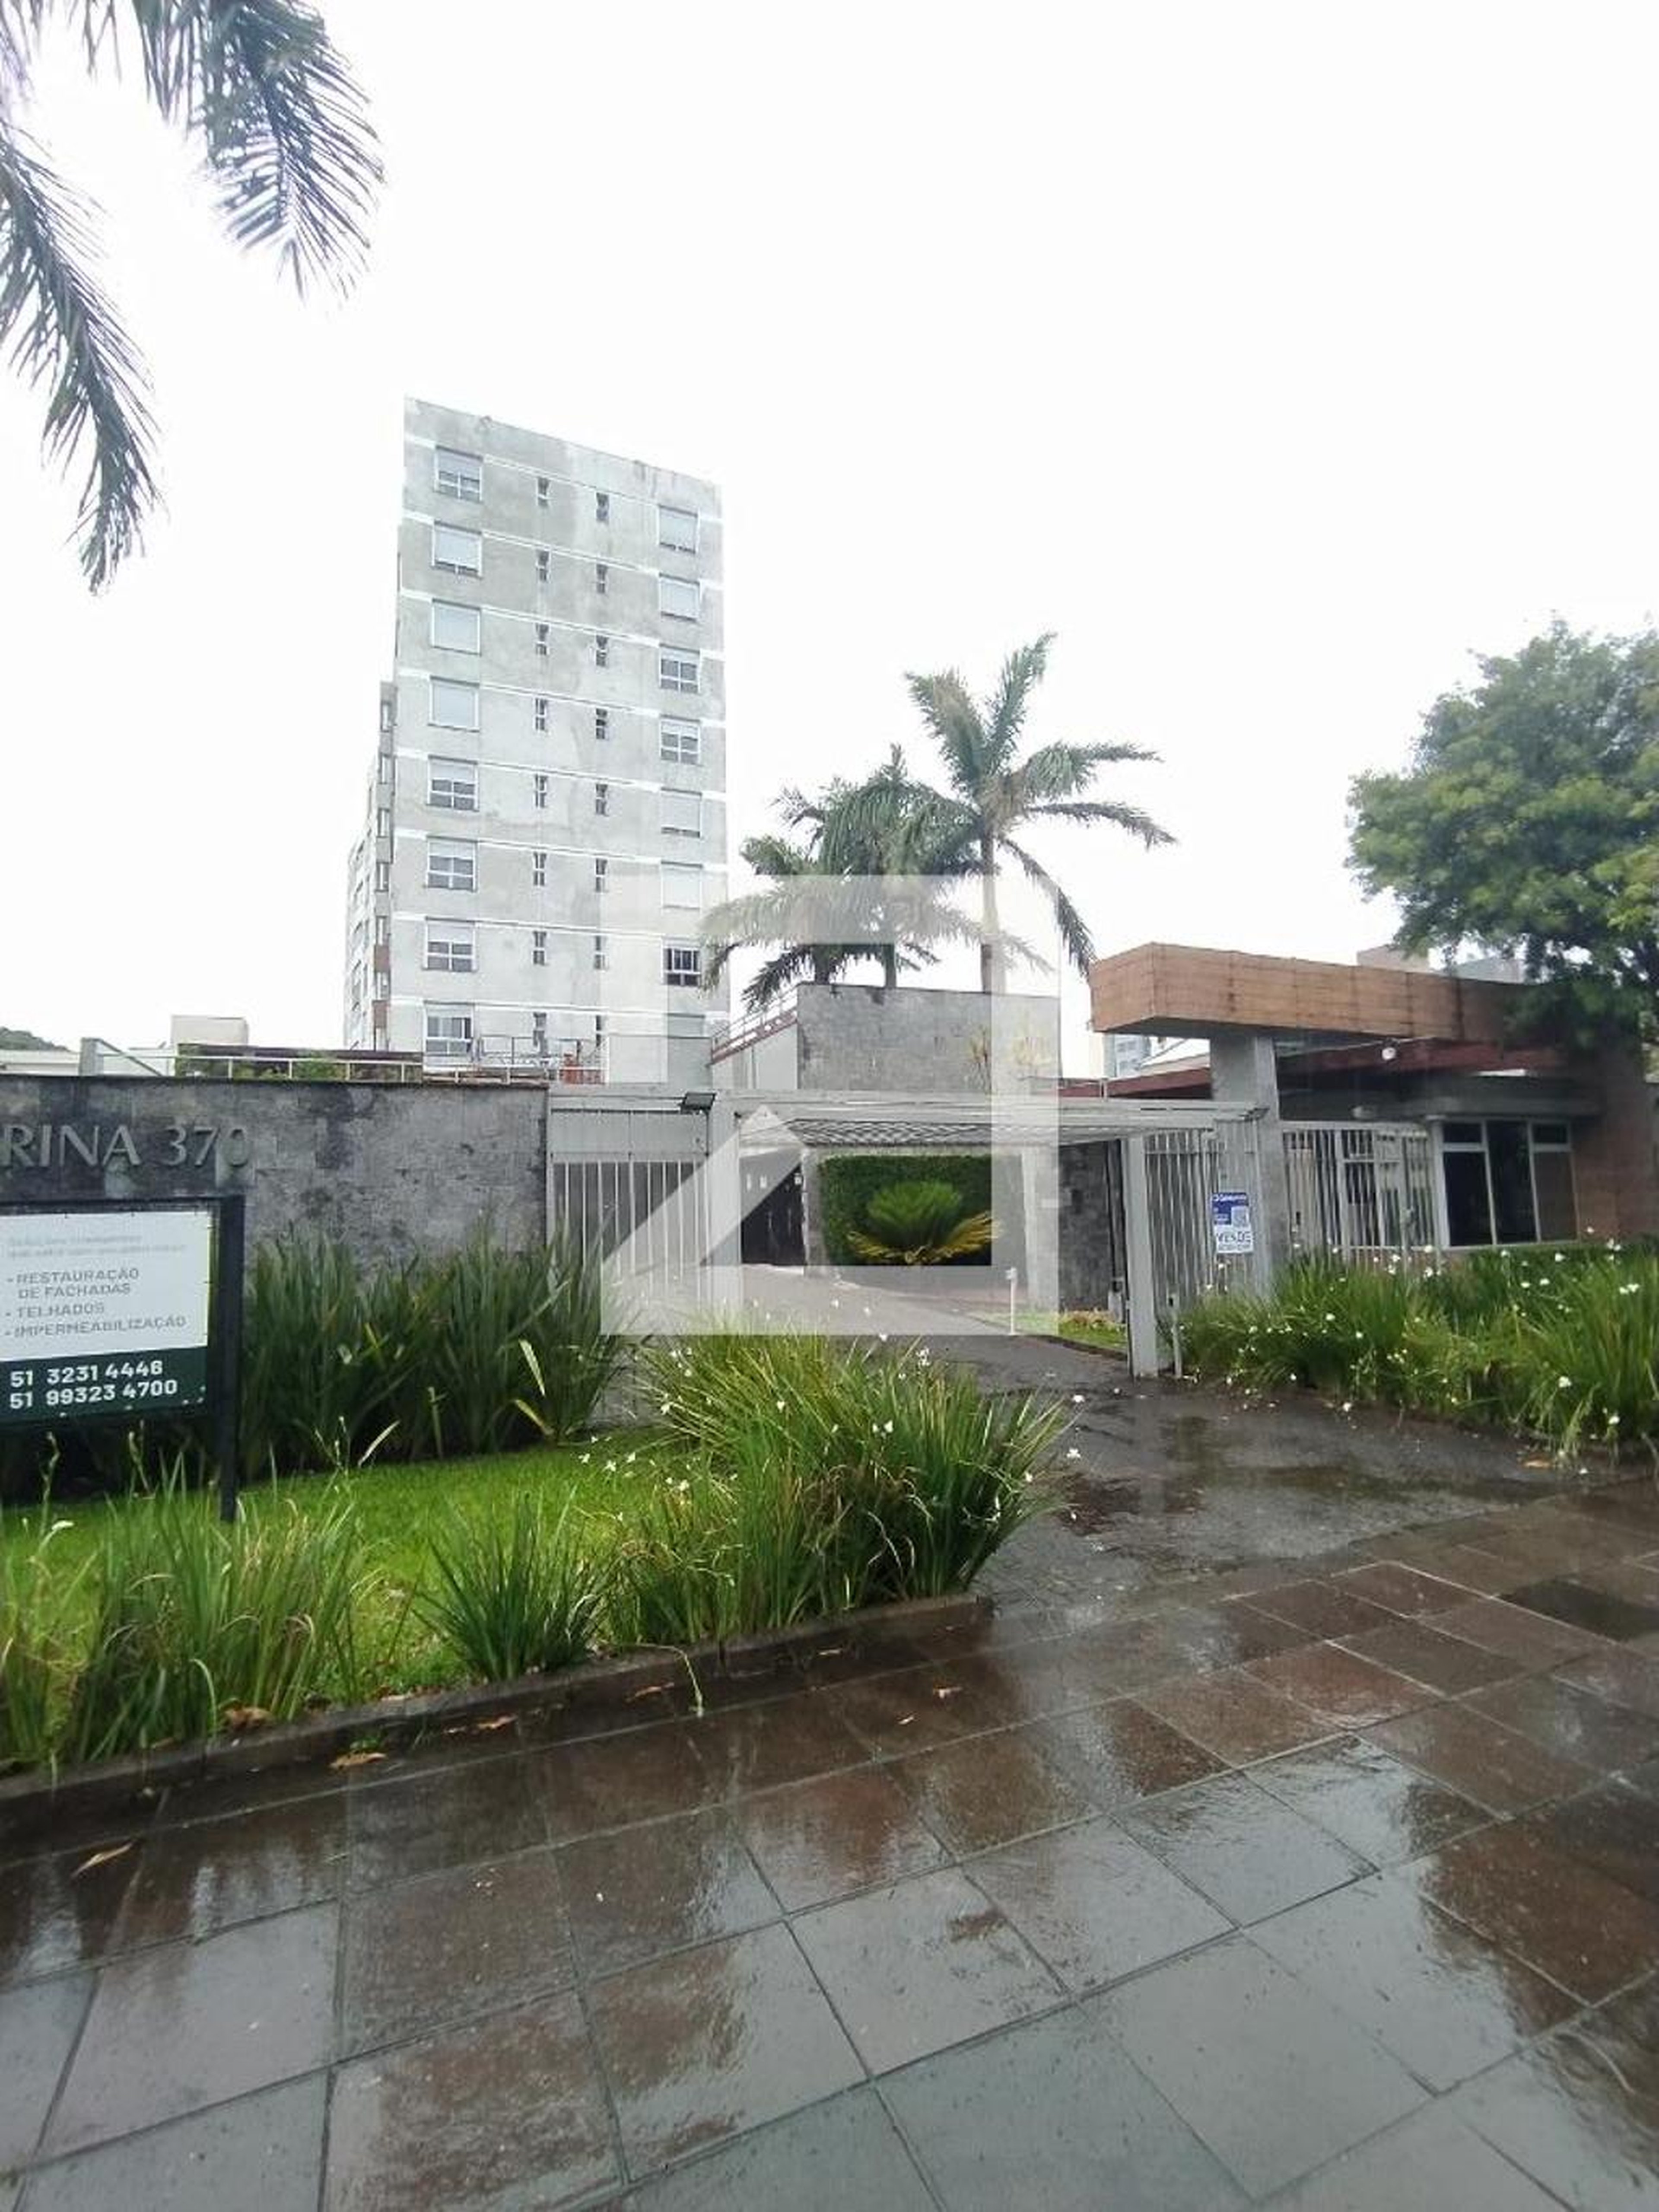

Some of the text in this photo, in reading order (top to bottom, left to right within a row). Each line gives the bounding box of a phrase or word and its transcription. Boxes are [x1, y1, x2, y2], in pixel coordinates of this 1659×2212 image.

[166, 1124, 251, 1168] 370
[17, 1267, 139, 1284] RESTAURAÇÃO
[19, 1283, 131, 1299] DE FACHADAS
[18, 1302, 105, 1318] TELHADOS
[14, 1315, 187, 1338] IMPERMEABILIZAÇÃO
[10, 1370, 33, 1387] 51
[46, 1365, 98, 1384] 3231
[10, 1380, 178, 1409] 51 99323 4700
